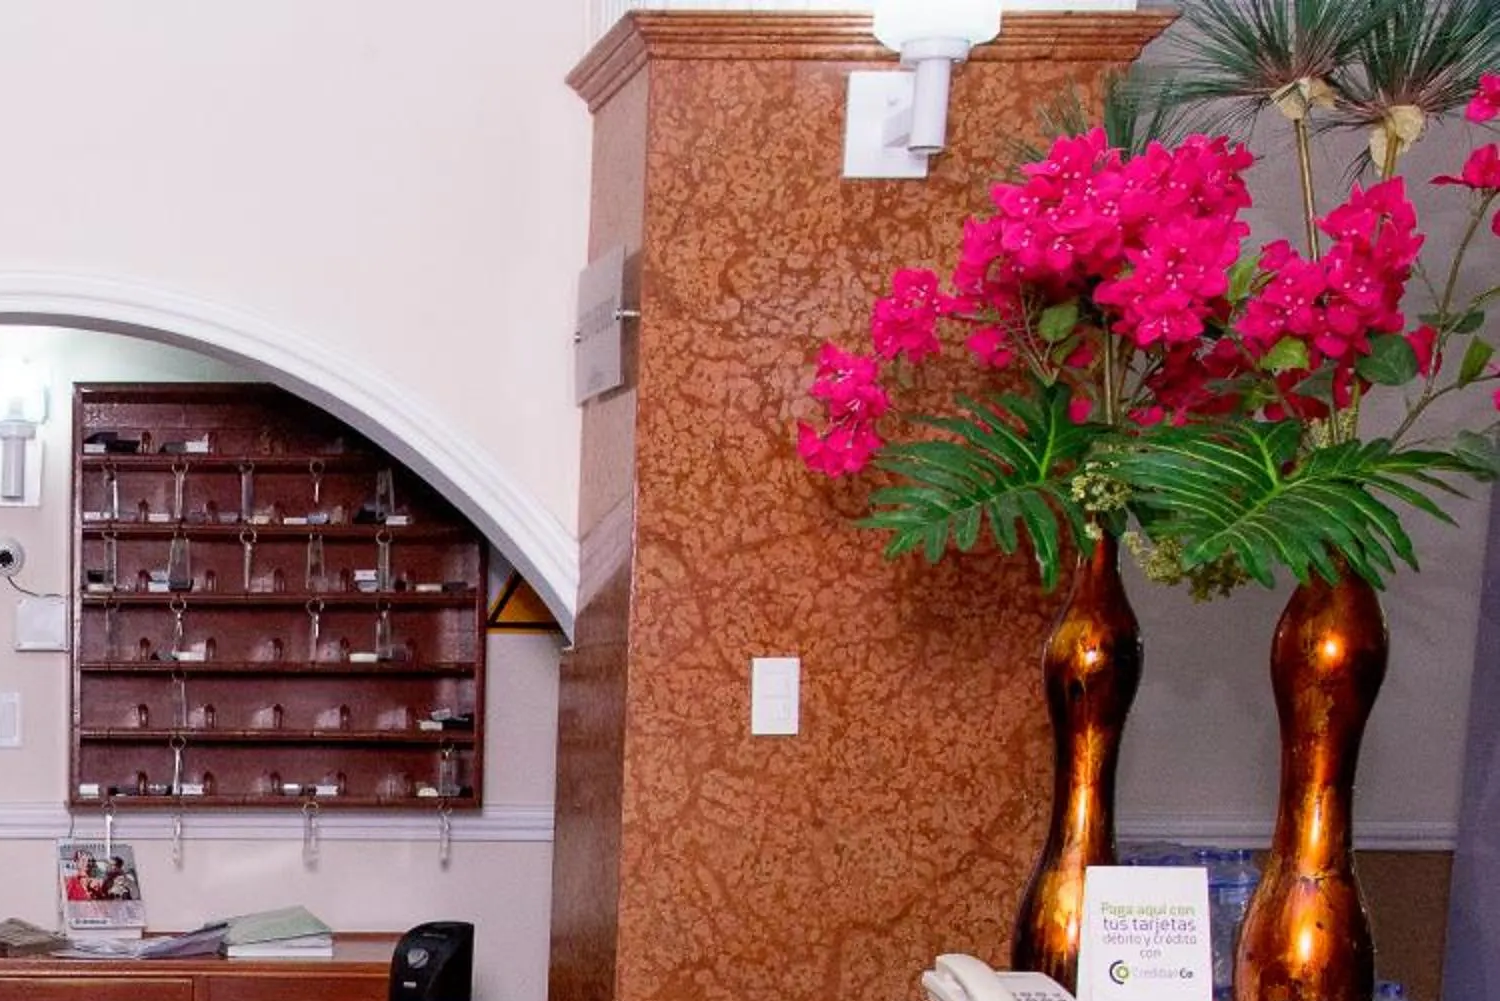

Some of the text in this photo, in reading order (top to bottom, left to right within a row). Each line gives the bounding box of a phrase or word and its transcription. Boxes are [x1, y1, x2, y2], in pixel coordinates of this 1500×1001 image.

[1103, 917, 1197, 936] tus tarjetas
[1143, 936, 1151, 947] y
[1140, 947, 1162, 958] con
